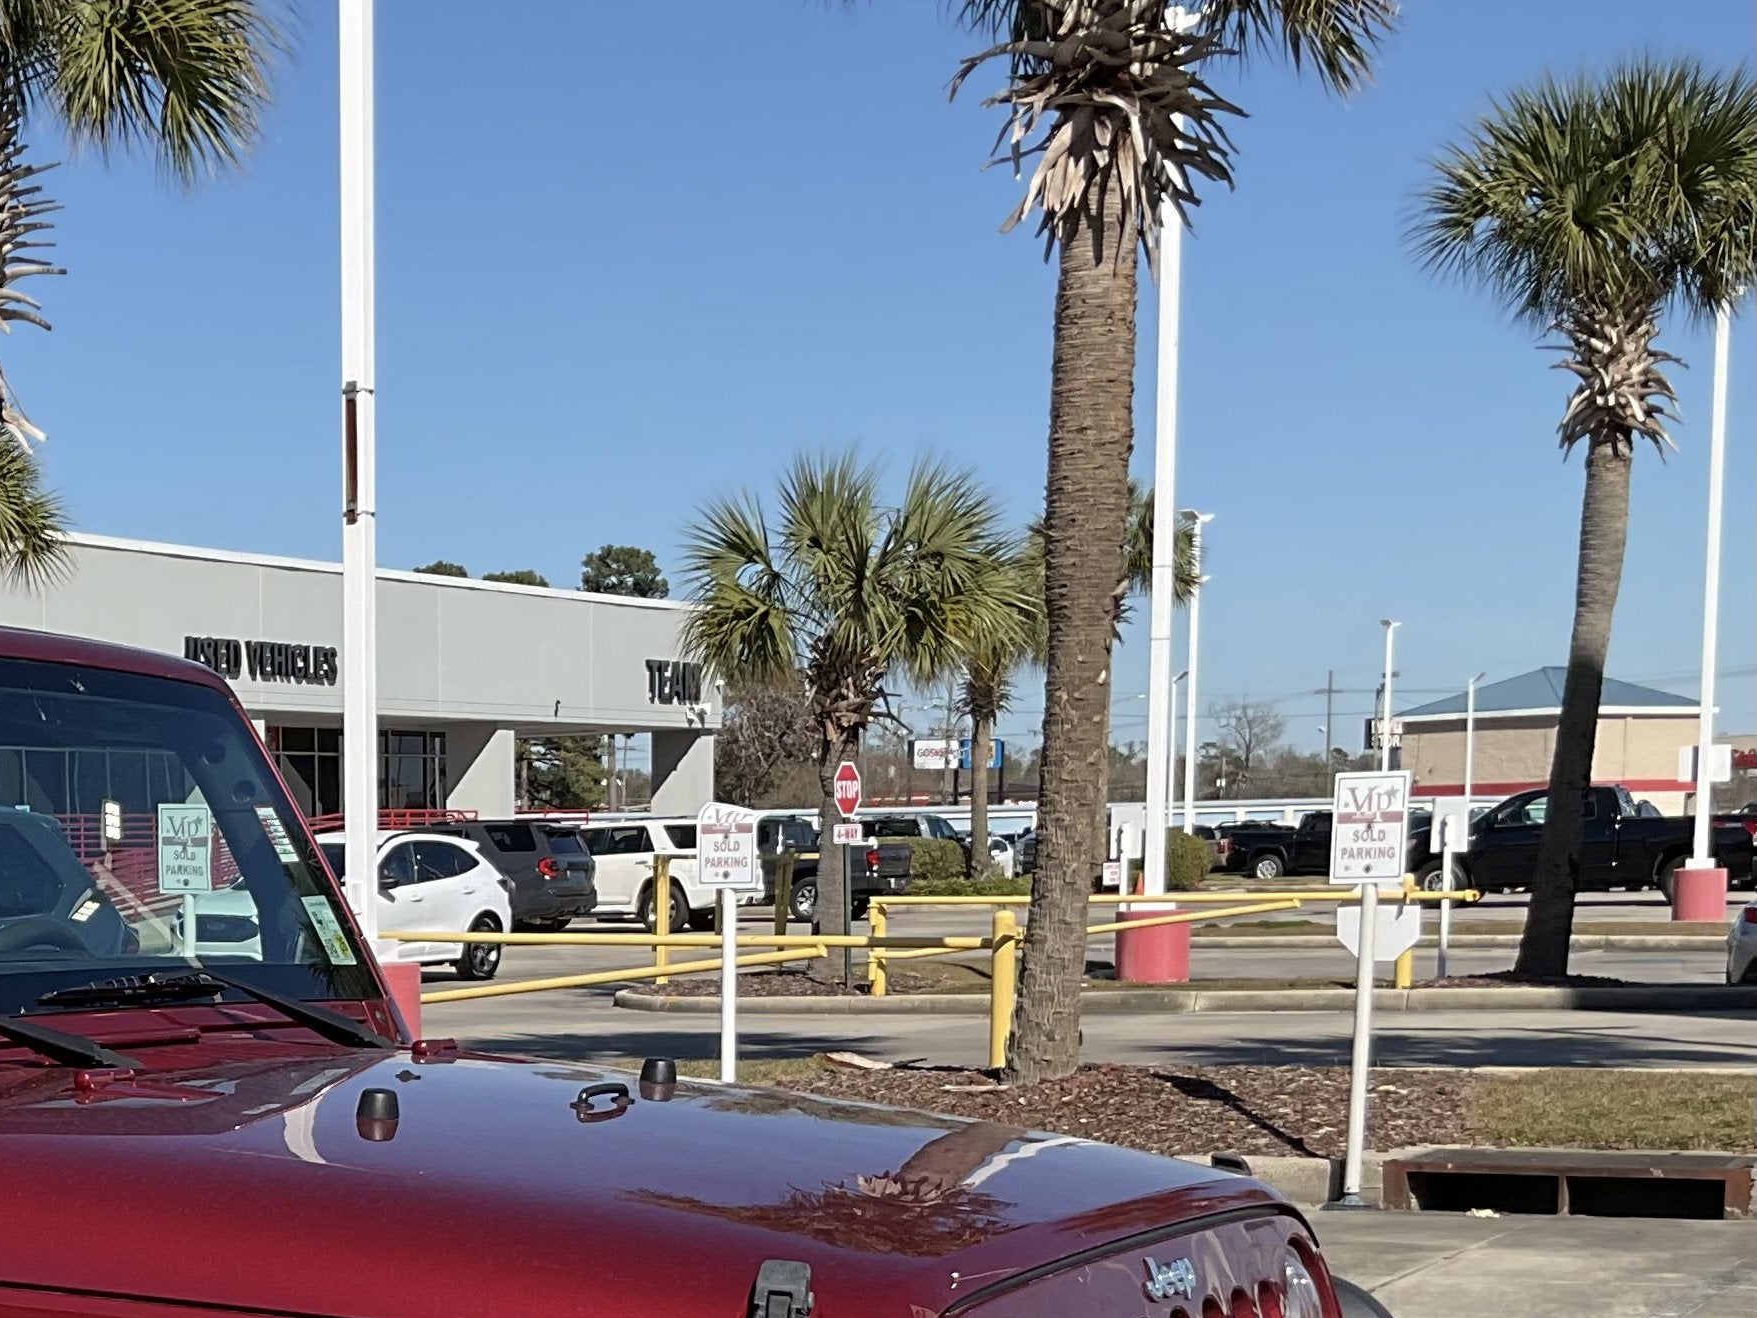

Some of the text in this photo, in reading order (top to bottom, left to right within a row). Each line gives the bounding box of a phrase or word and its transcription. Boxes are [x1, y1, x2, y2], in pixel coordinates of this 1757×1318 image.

[184, 636, 338, 686] USED VEHICLES
[836, 780, 859, 799] STOP
[836, 827, 858, 840] 4-WAY
[1352, 829, 1386, 843] SOLD
[713, 840, 740, 852] SOLD
[173, 850, 196, 861] SOLD
[1340, 846, 1396, 860] PARKING
[704, 856, 748, 868] PARKING
[165, 864, 204, 877] PARKING
[1143, 1257, 1196, 1302] Jeep
